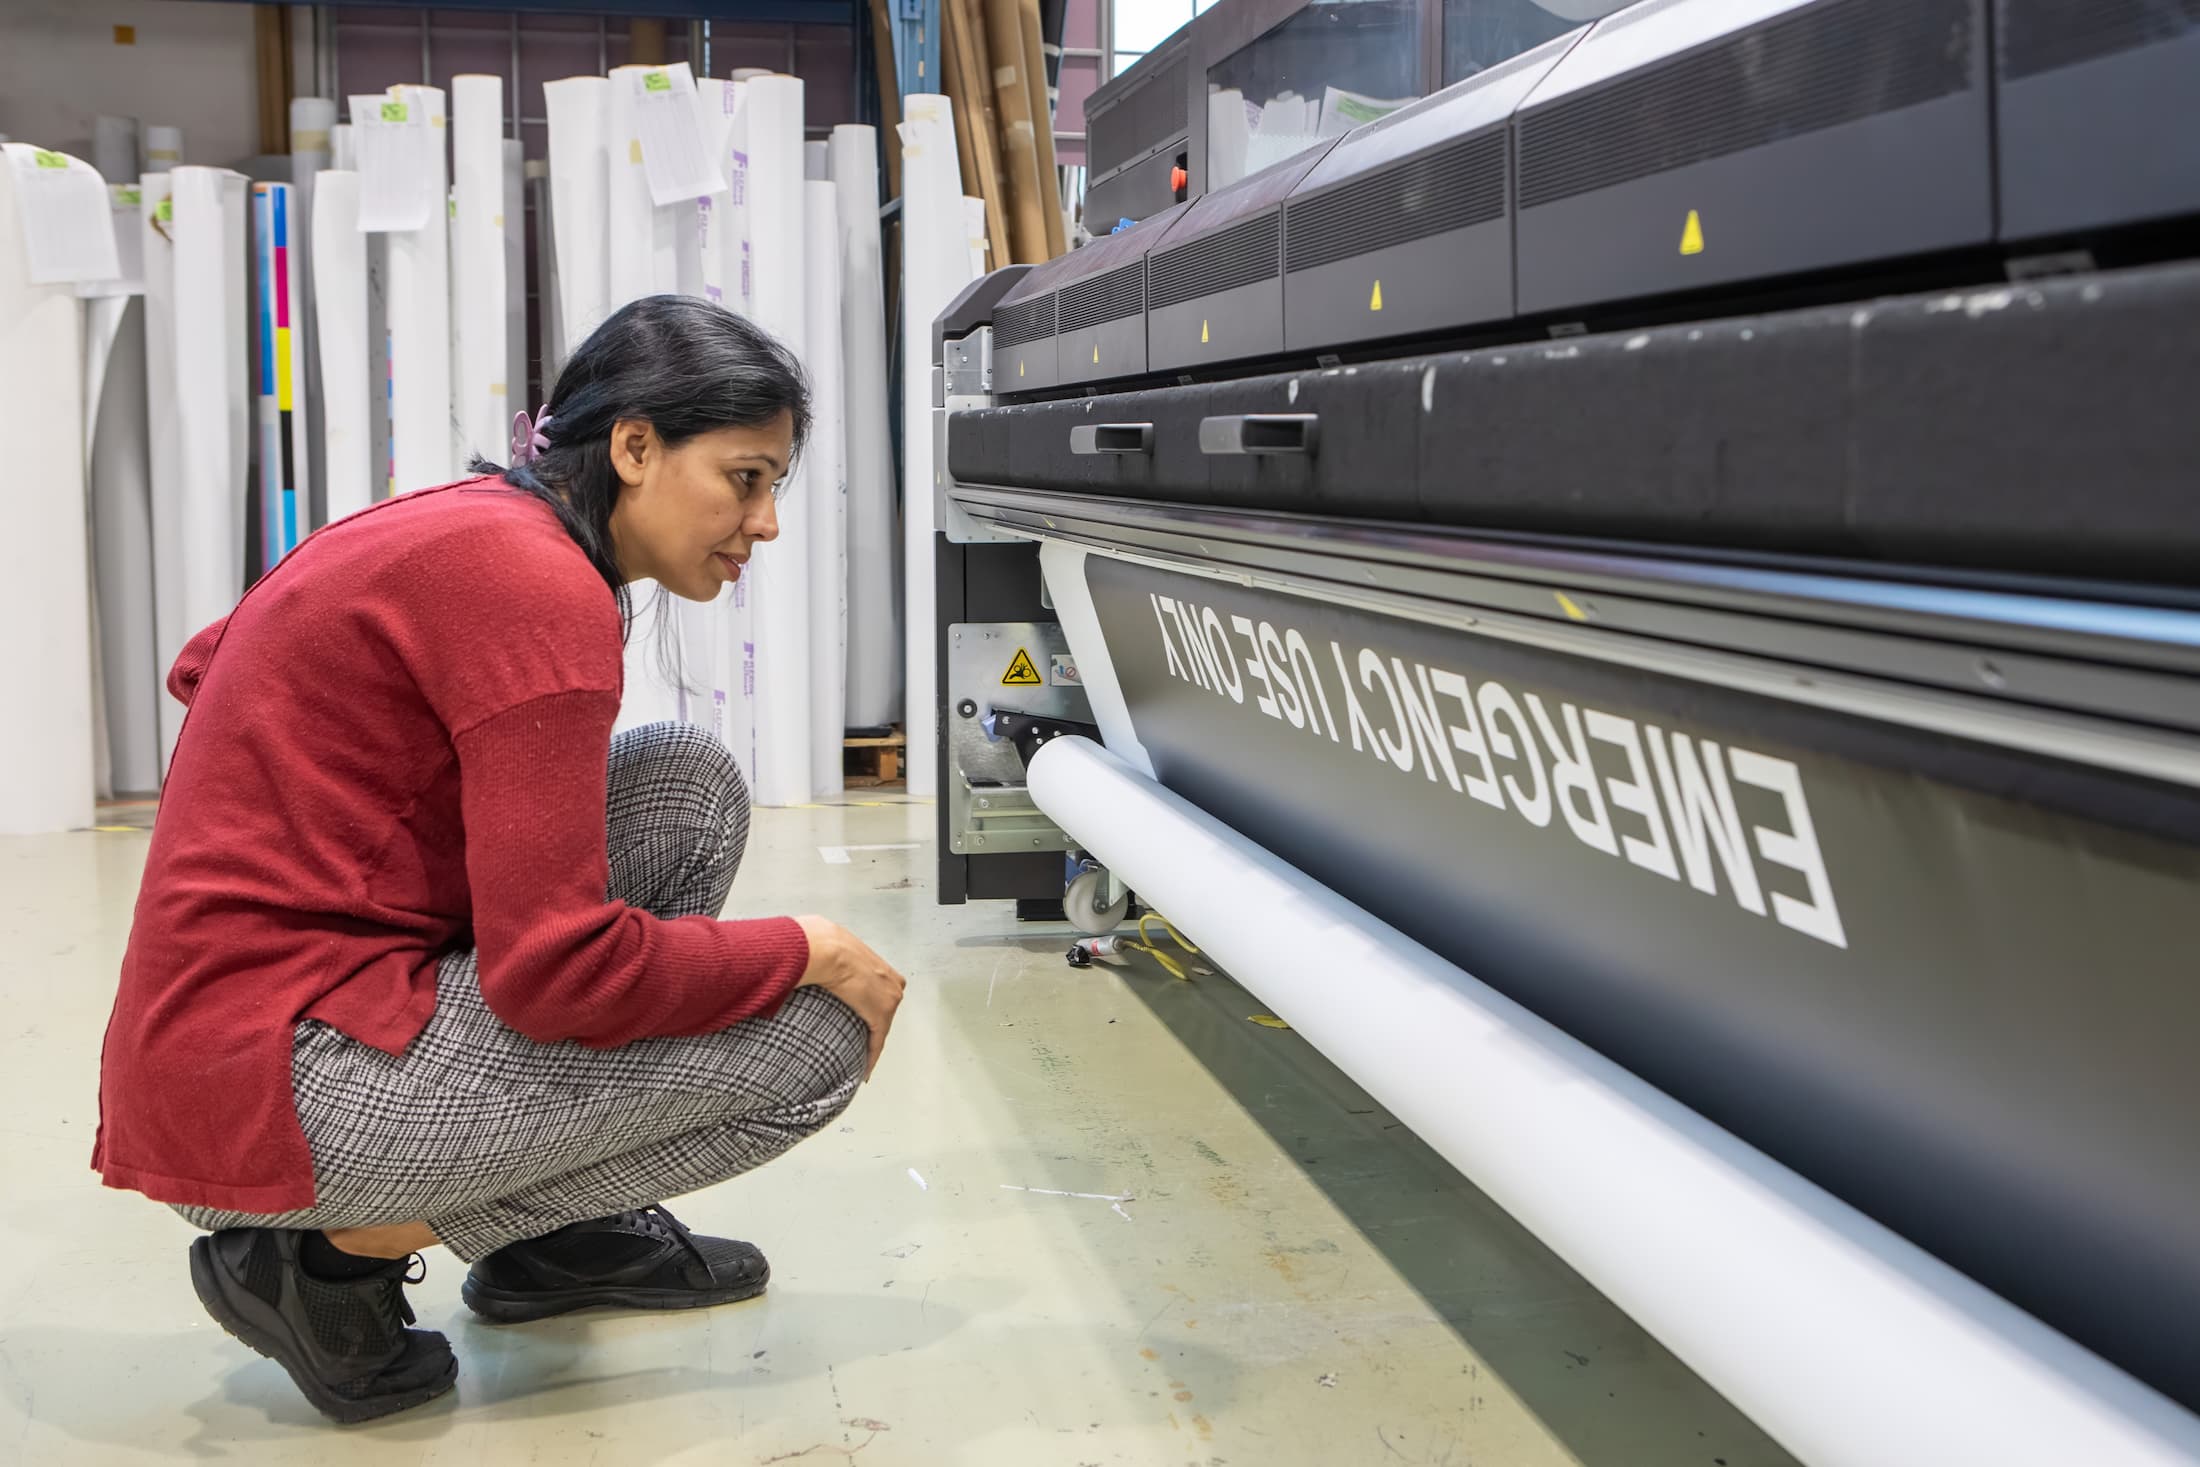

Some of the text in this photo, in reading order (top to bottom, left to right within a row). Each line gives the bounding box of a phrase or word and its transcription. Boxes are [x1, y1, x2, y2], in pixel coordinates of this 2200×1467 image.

[1150, 593, 1848, 949] EMERGENCY USE ONLY
